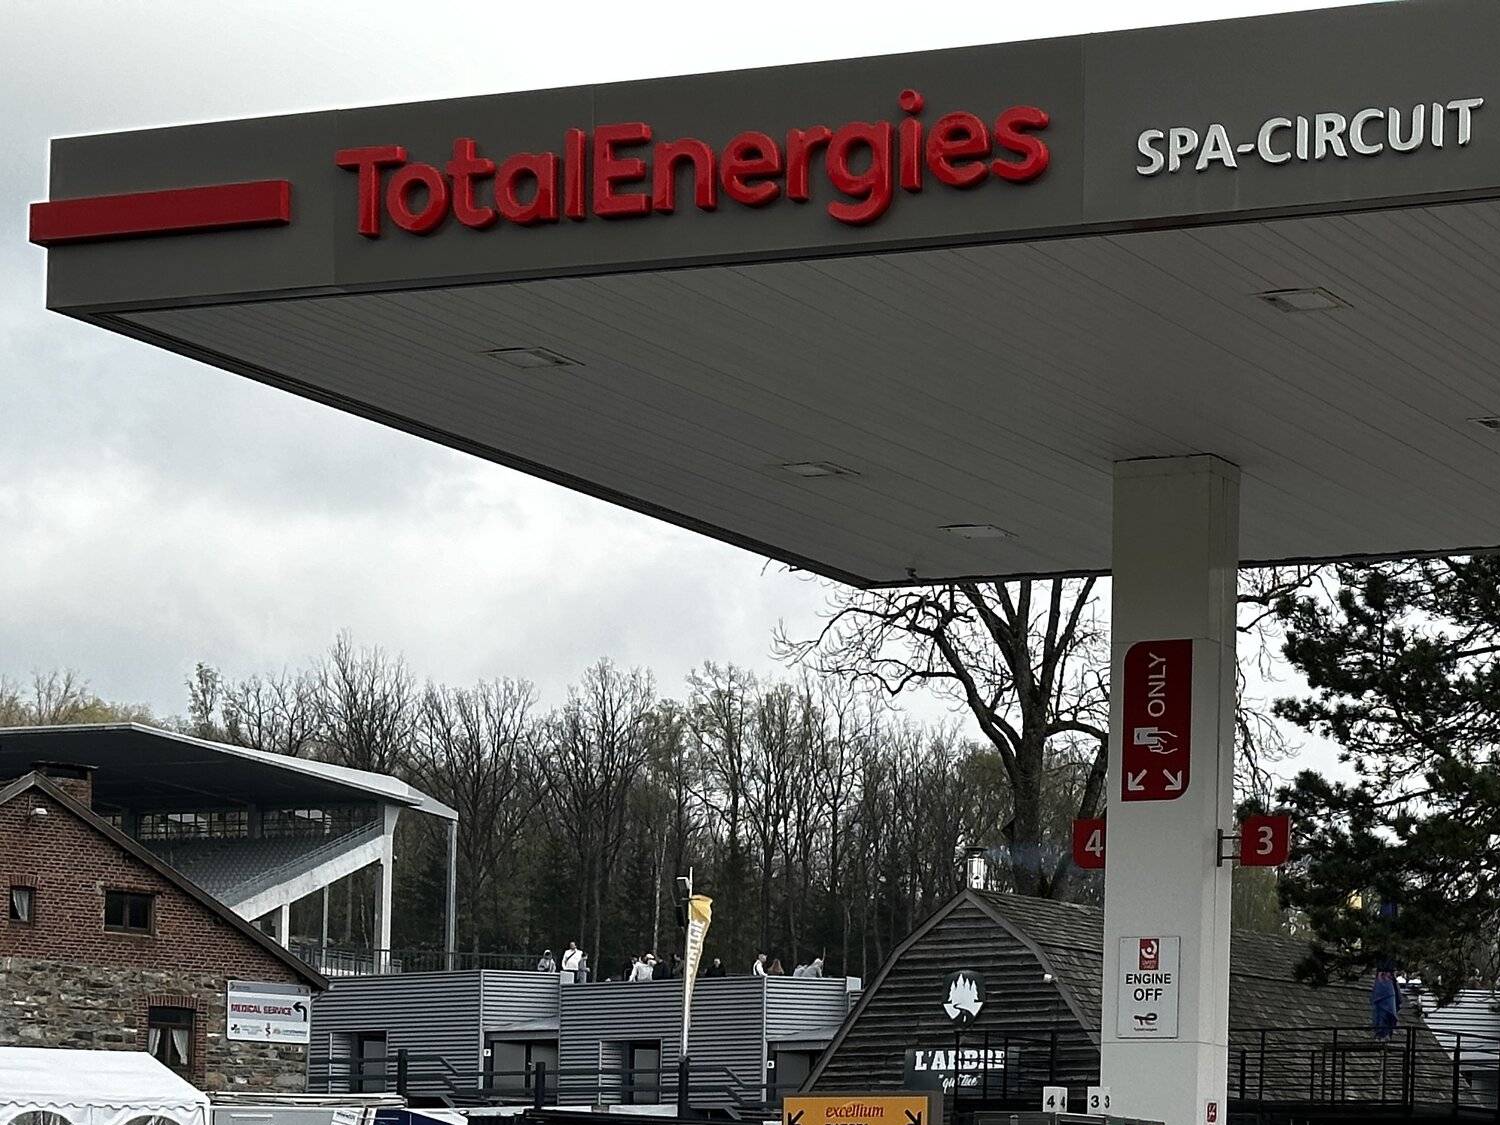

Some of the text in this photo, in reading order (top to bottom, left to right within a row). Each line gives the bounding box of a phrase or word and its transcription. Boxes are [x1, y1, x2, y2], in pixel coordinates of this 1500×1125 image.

[1135, 97, 1485, 177] SPA-CIRCUIT
[335, 88, 1051, 239] TotalEnergies
[1147, 652, 1167, 718] ONLY
[1085, 829, 1104, 858] 4
[1255, 826, 1274, 855] 3
[1125, 973, 1172, 985] ENGINE
[1133, 988, 1163, 1002] OFF
[231, 1004, 292, 1016] MEDICAL SERVICE
[914, 1050, 1005, 1071] L'ARBRE
[825, 1102, 884, 1118] excellium
[1046, 1095, 1056, 1109] 4
[1090, 1095, 1100, 1109] 3
[1104, 1096, 1110, 1109] 3
